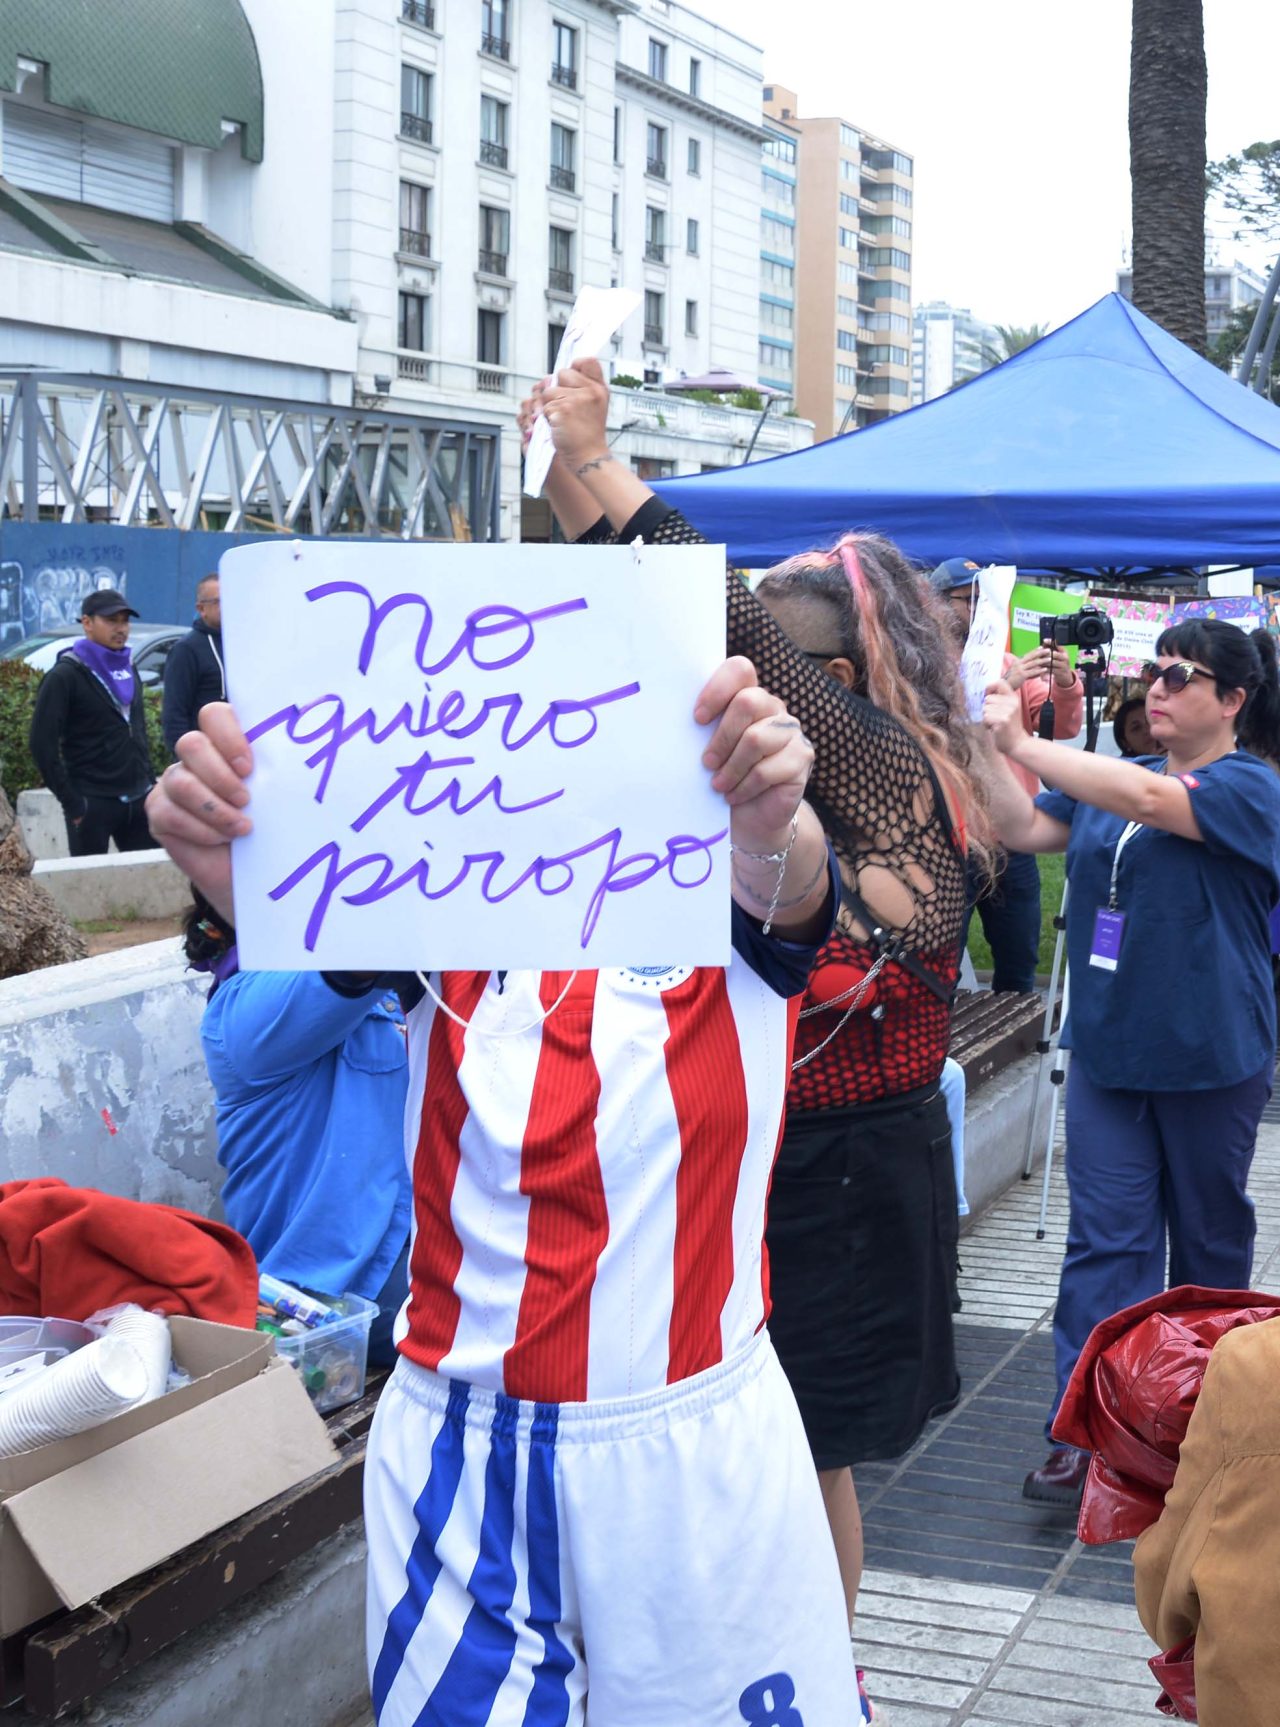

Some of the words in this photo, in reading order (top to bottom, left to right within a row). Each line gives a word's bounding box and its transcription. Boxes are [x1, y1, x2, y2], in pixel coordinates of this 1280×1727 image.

[245, 680, 641, 804] quiero
[350, 750, 566, 833] tu
[267, 827, 729, 952] piropo
[739, 1671, 804, 1727] 8
